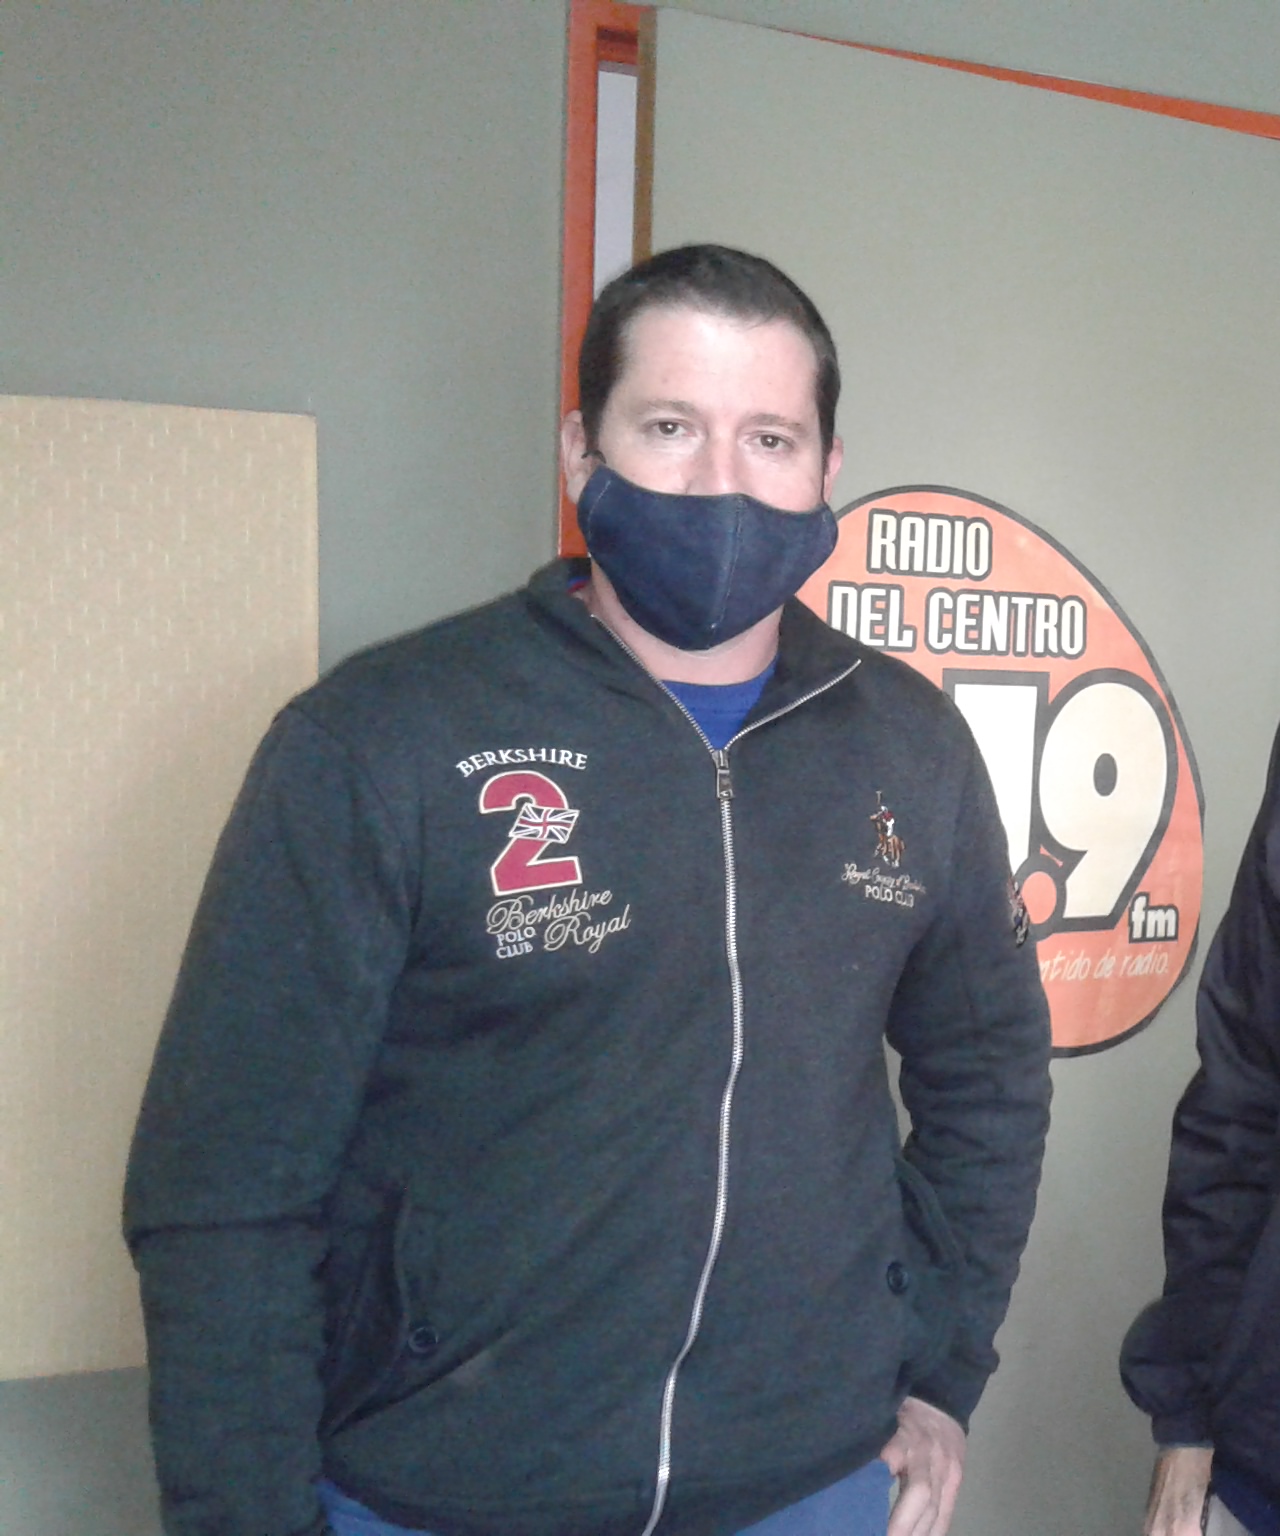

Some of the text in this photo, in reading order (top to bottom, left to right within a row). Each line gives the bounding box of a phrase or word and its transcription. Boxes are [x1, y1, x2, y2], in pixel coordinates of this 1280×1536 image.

[868, 511, 992, 579] RADIO
[829, 583, 1085, 657] DEL CENTRO
[456, 748, 588, 777] BERKSHIRE
[478, 769, 583, 896] 2
[486, 889, 613, 935] Berkshire
[864, 884, 893, 902] POLO
[496, 926, 536, 947] POLO
[544, 904, 632, 954] Royal
[1131, 895, 1177, 940] fm
[496, 942, 534, 959] CLUB
[1093, 948, 1116, 979] de
